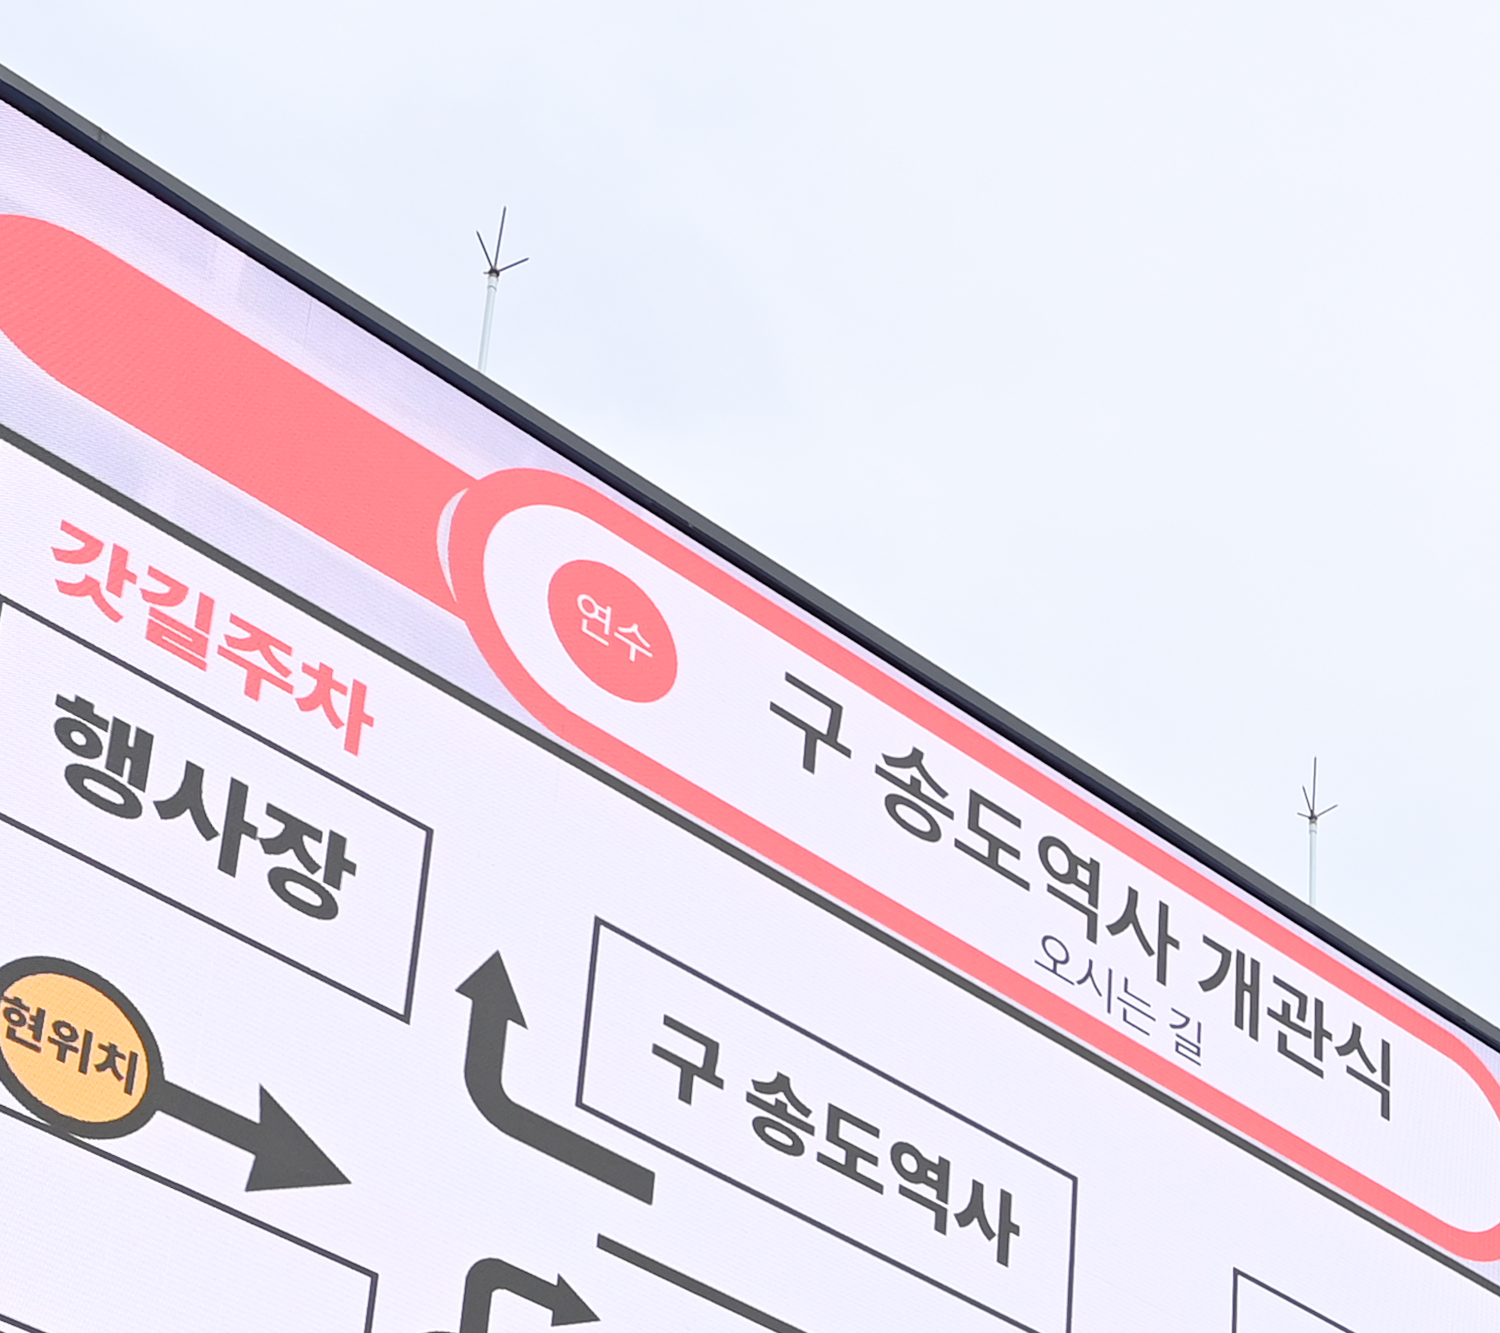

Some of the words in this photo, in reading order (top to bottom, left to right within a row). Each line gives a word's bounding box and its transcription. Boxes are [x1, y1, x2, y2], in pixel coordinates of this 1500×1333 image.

[51, 519, 374, 757] 갓길주차
[577, 594, 653, 662] 연수
[53, 694, 357, 920] 행사장
[769, 671, 852, 774] 구
[875, 746, 1180, 986] 송도역사
[1198, 934, 1391, 1121] 개관식
[1, 996, 139, 1096] 현위치
[1034, 935, 1156, 1036] 오시는
[1169, 1007, 1202, 1066] 길
[652, 1014, 725, 1106] 구
[745, 1071, 1021, 1268] 송도역사
